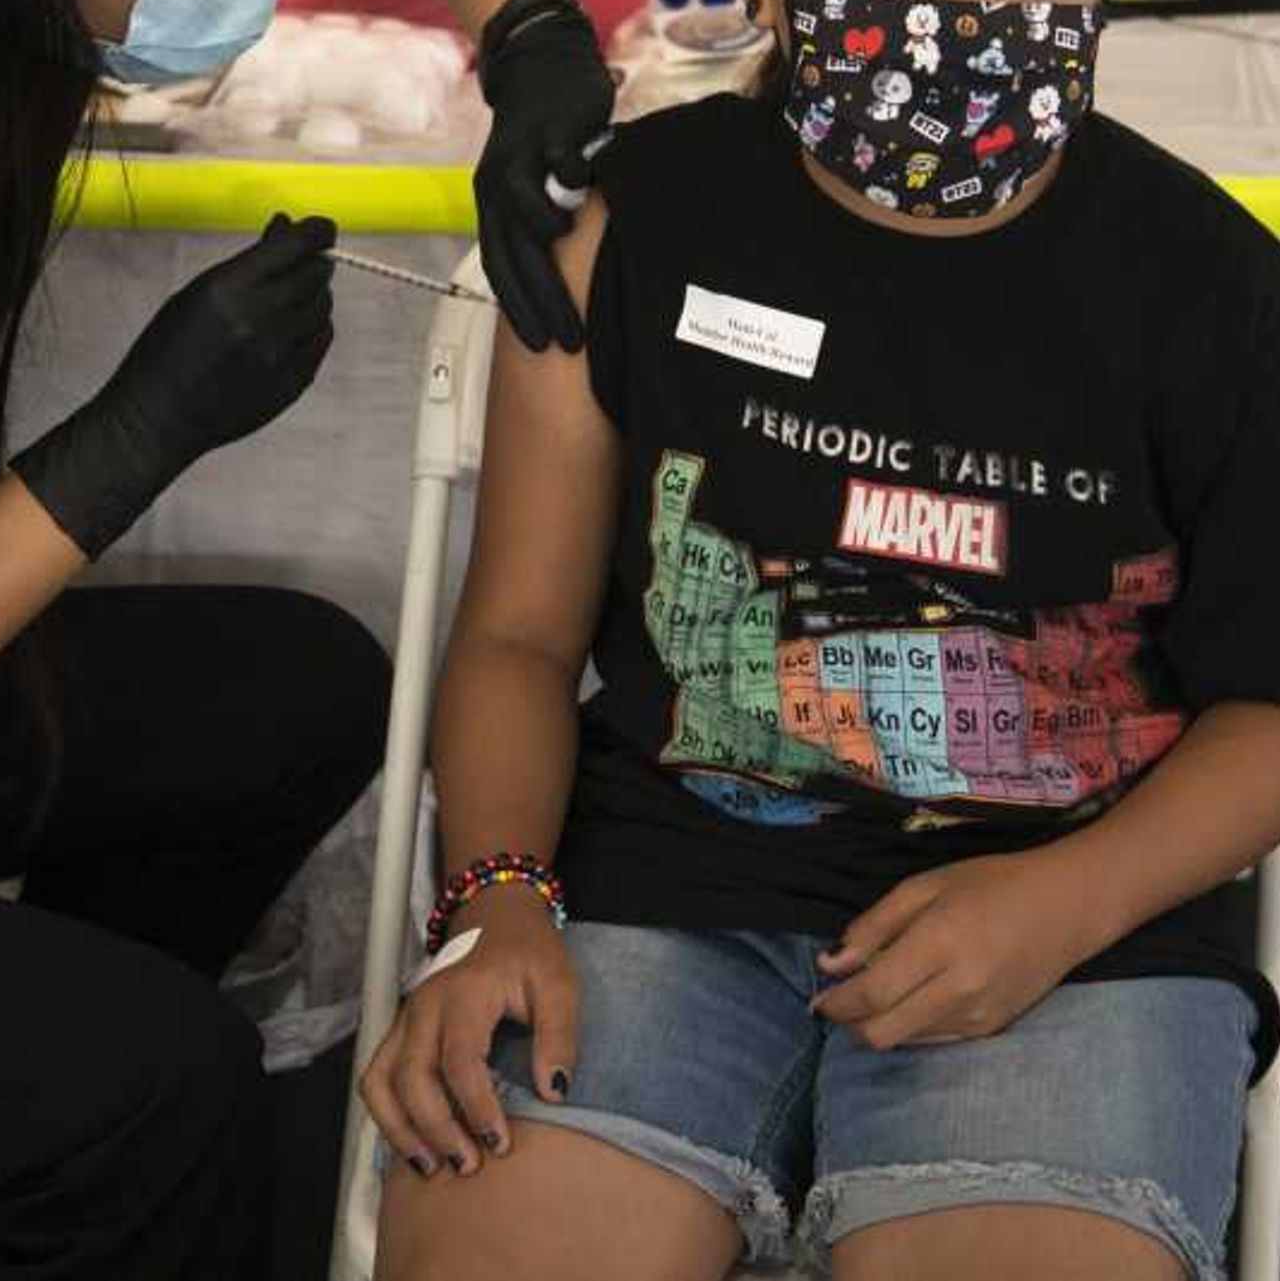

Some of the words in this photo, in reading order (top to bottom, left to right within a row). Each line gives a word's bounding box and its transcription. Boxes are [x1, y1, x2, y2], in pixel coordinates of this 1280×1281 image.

[741, 397, 912, 472] PERIODIC
[933, 444, 1049, 496] TABLE
[1064, 467, 1117, 505] OF
[663, 470, 687, 495] Ca
[842, 485, 1001, 568] MARVEL
[744, 606, 773, 627] An
[822, 646, 855, 666] Bb
[863, 646, 896, 668] Me
[907, 647, 936, 669] Gr
[945, 649, 977, 672] Ms
[869, 707, 900, 731] Kn
[910, 707, 941, 737] Cy
[993, 710, 1019, 733] Gr
[886, 754, 918, 777] Tn
